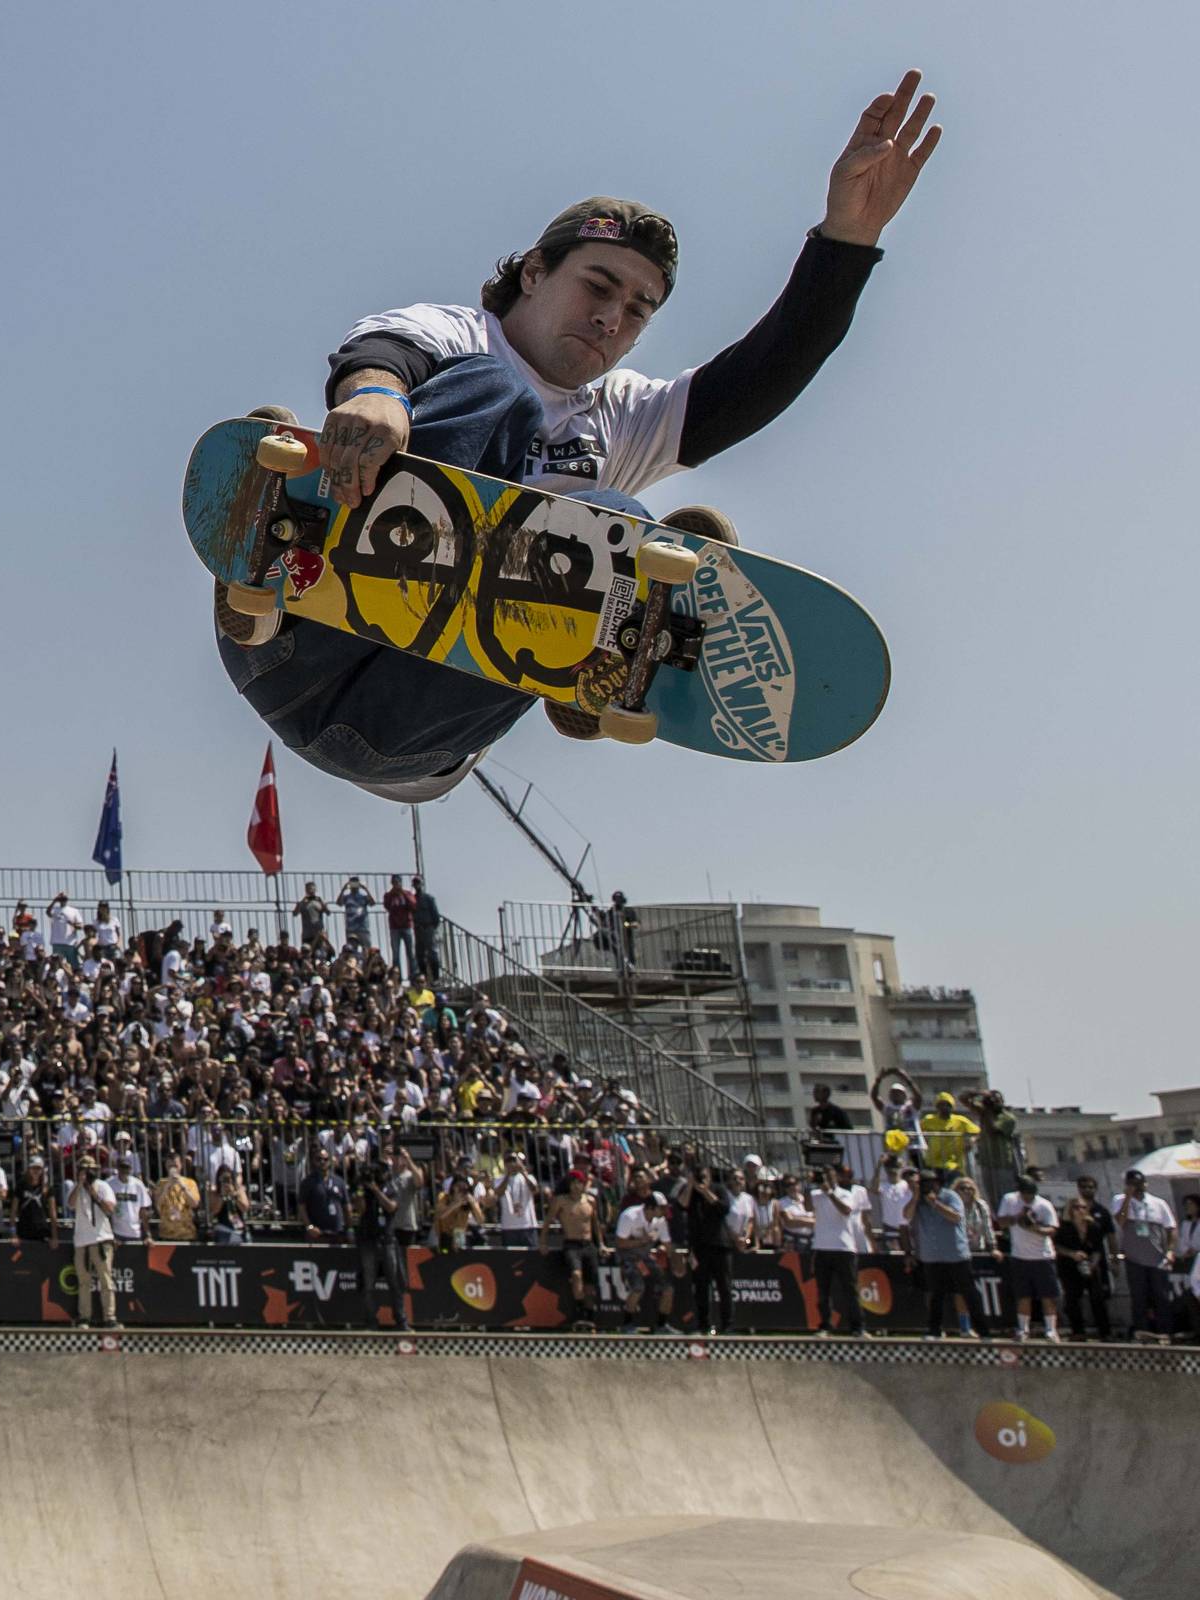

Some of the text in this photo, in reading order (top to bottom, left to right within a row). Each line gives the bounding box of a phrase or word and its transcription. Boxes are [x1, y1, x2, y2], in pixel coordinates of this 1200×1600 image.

[580, 227, 619, 240] Red Bull
[552, 440, 601, 458] WALL
[597, 596, 616, 647] SKATEBOARDING
[704, 615, 753, 681] THE
[191, 1266, 243, 1308] TNT
[464, 1276, 484, 1298] oi
[742, 1290, 782, 1303] PAULO
[860, 1281, 880, 1302] oi
[998, 1420, 1026, 1447] oi
